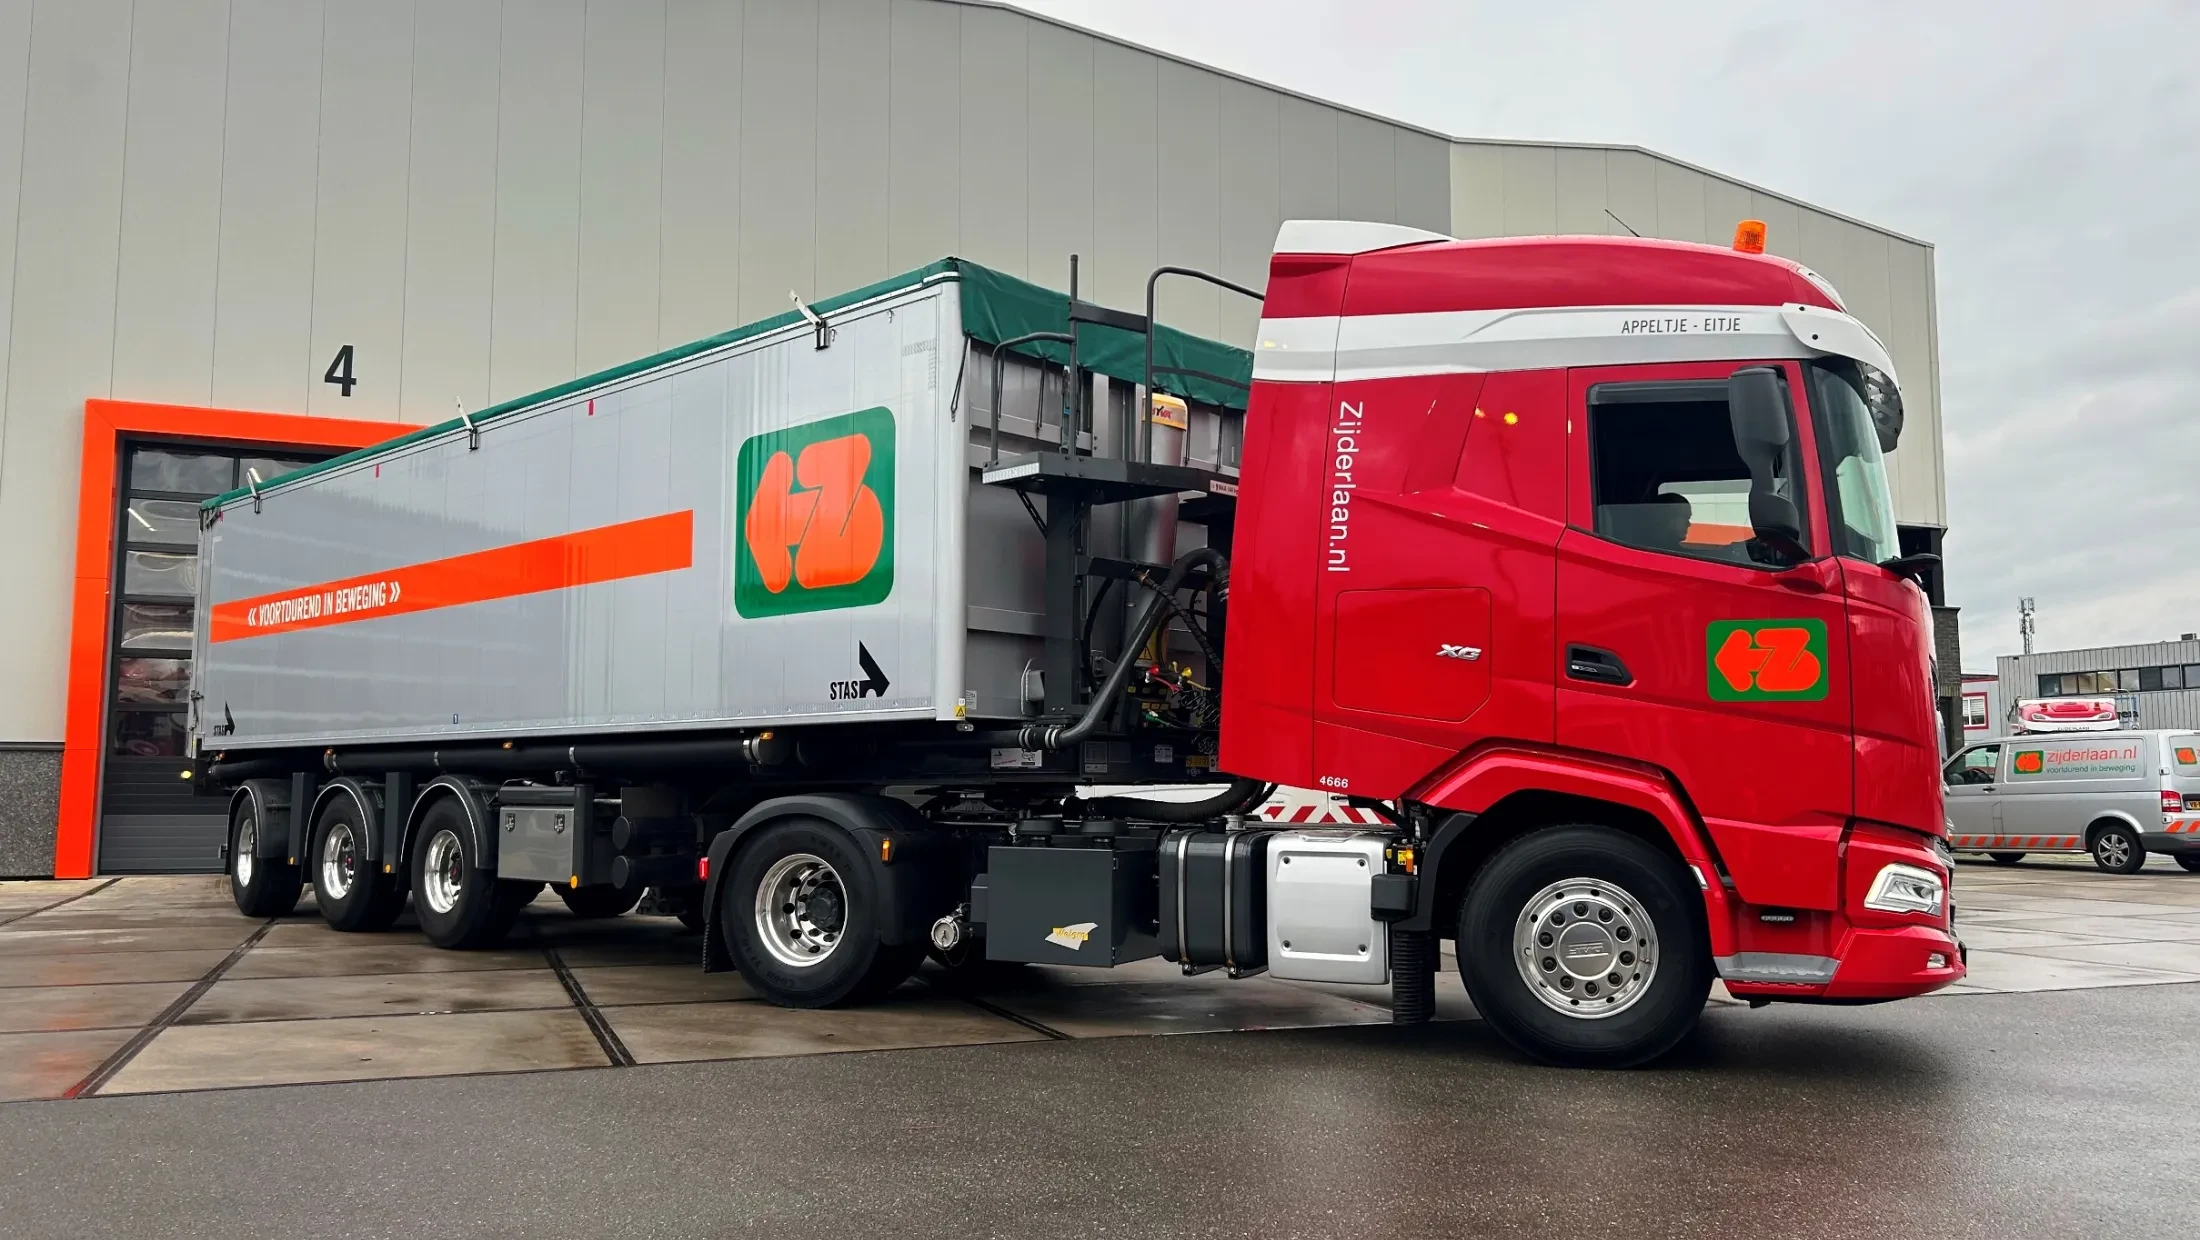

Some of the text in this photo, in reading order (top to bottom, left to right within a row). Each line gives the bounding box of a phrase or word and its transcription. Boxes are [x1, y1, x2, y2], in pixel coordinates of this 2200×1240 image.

[1621, 318, 1688, 334] APPELTJE
[1704, 317, 1741, 331] EITJE
[324, 344, 357, 397] 4
[1327, 401, 1363, 572] Zijderlaan.nl
[259, 582, 387, 626] VOORTDUREND IN BEWEGING
[1436, 643, 1482, 661] XG
[830, 680, 858, 700] STAS
[2046, 746, 2137, 765] zijderlaan.nl
[1319, 775, 1349, 789] 4666
